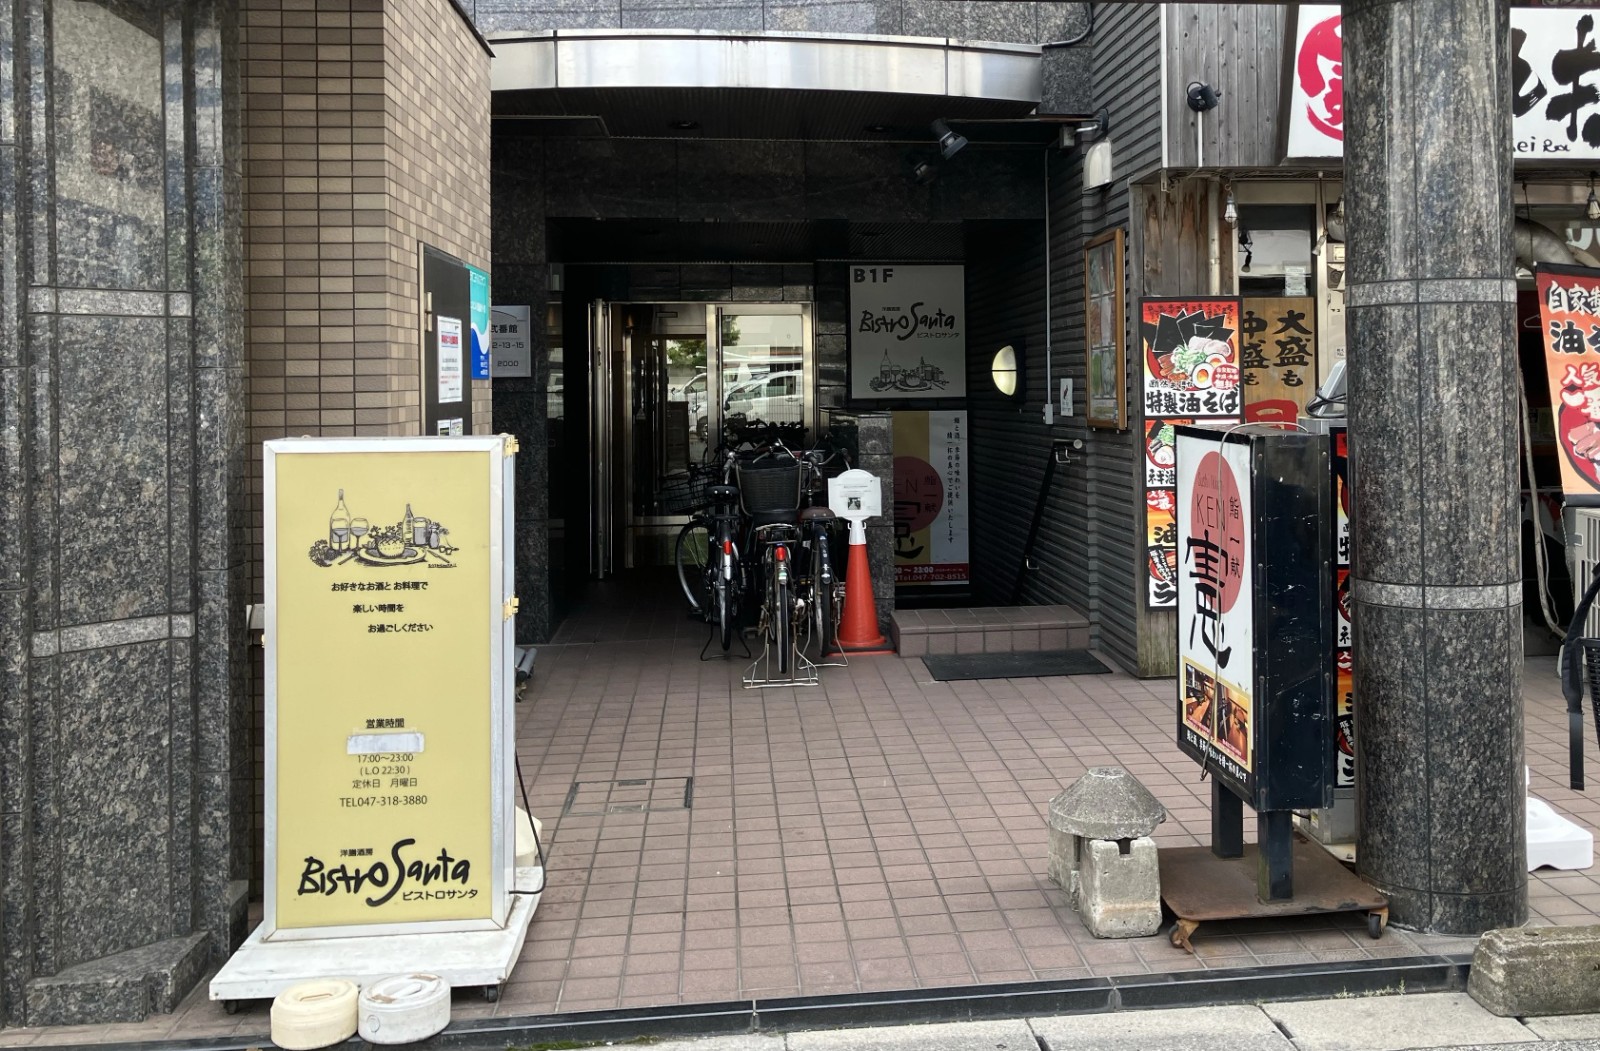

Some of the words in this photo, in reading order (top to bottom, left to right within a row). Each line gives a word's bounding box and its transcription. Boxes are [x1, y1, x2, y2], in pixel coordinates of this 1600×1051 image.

[1146, 383, 1240, 415] 特製油そば
[353, 603, 404, 614] 楽しい時間を
[367, 622, 434, 634] お過ごしください
[365, 717, 405, 730] 営業時間
[352, 779, 381, 789] 定休日
[390, 777, 418, 788] 月曜日
[339, 795, 428, 808] TEL047-318-3880
[402, 888, 479, 901] ビストロサンタ
